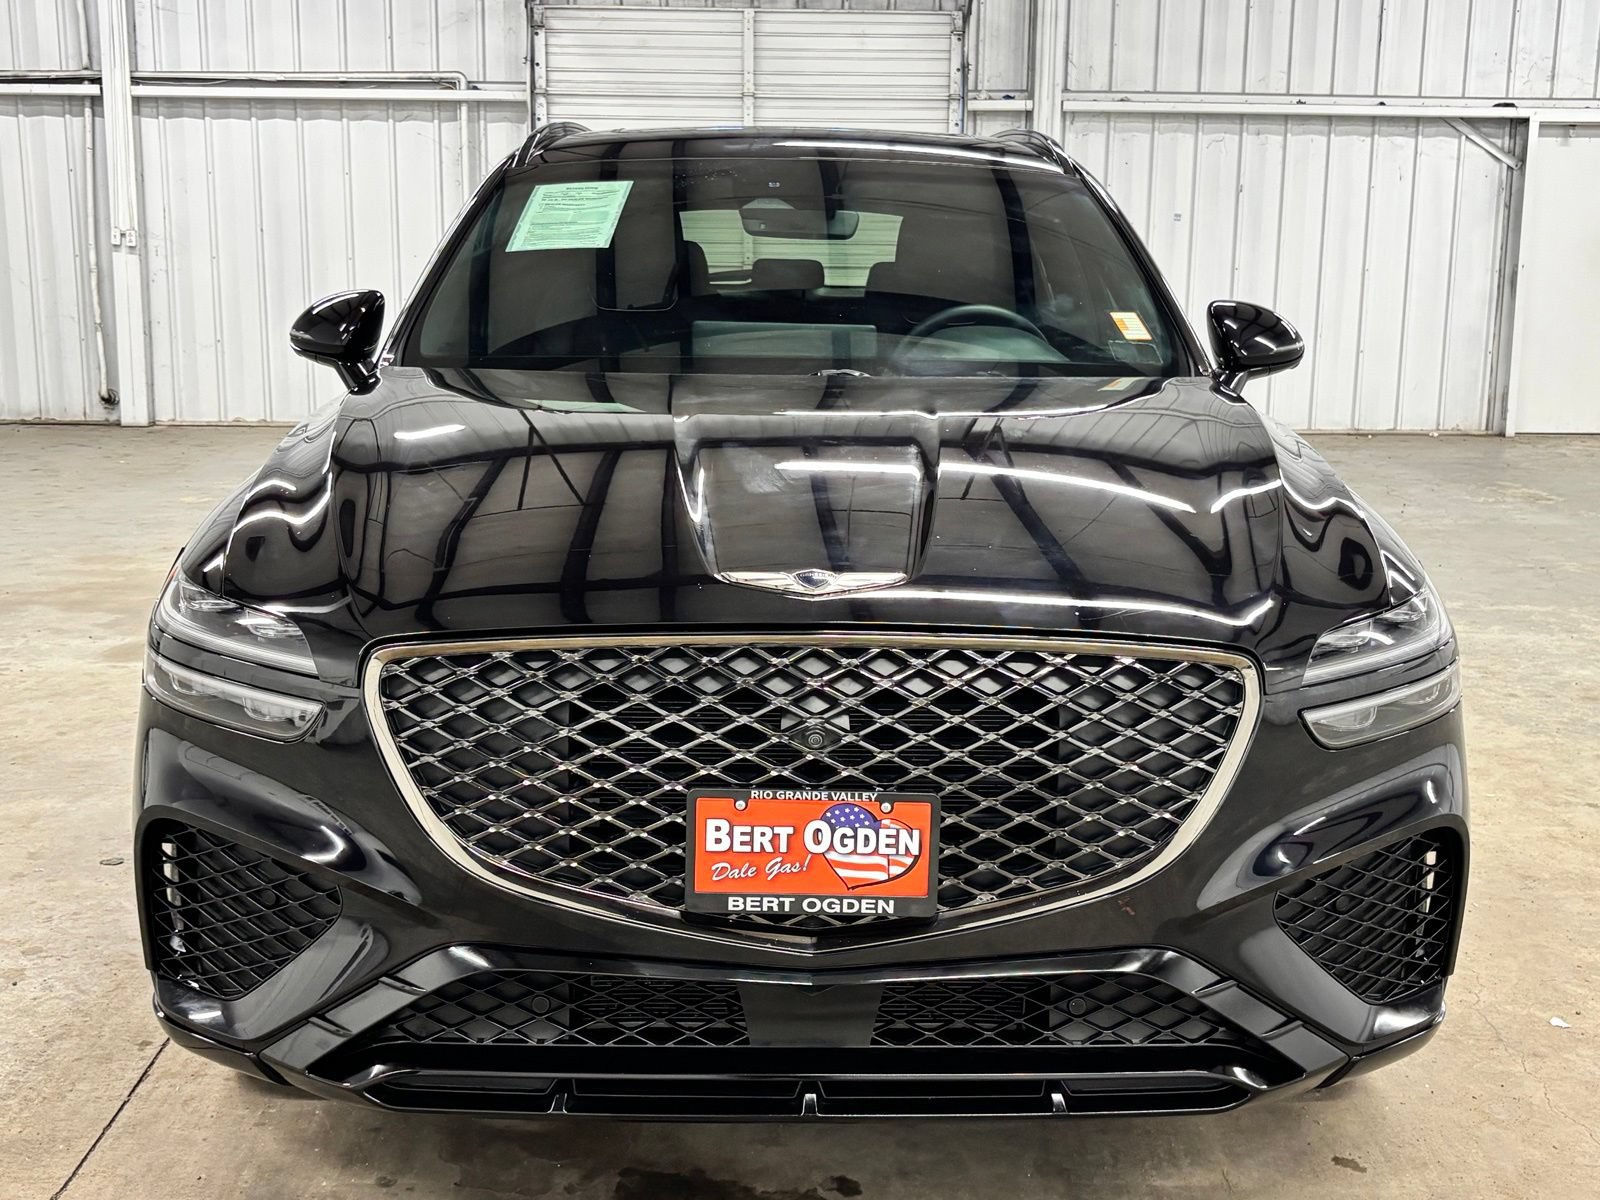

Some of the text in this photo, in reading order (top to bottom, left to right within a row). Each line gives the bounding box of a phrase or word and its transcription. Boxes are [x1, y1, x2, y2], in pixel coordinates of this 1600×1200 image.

[751, 790, 878, 802] RIO GRANDE VALLEY
[705, 818, 921, 856] BERT OGDEN
[712, 853, 812, 881] Dale Gas!
[727, 896, 895, 914] BERT OGDEN
